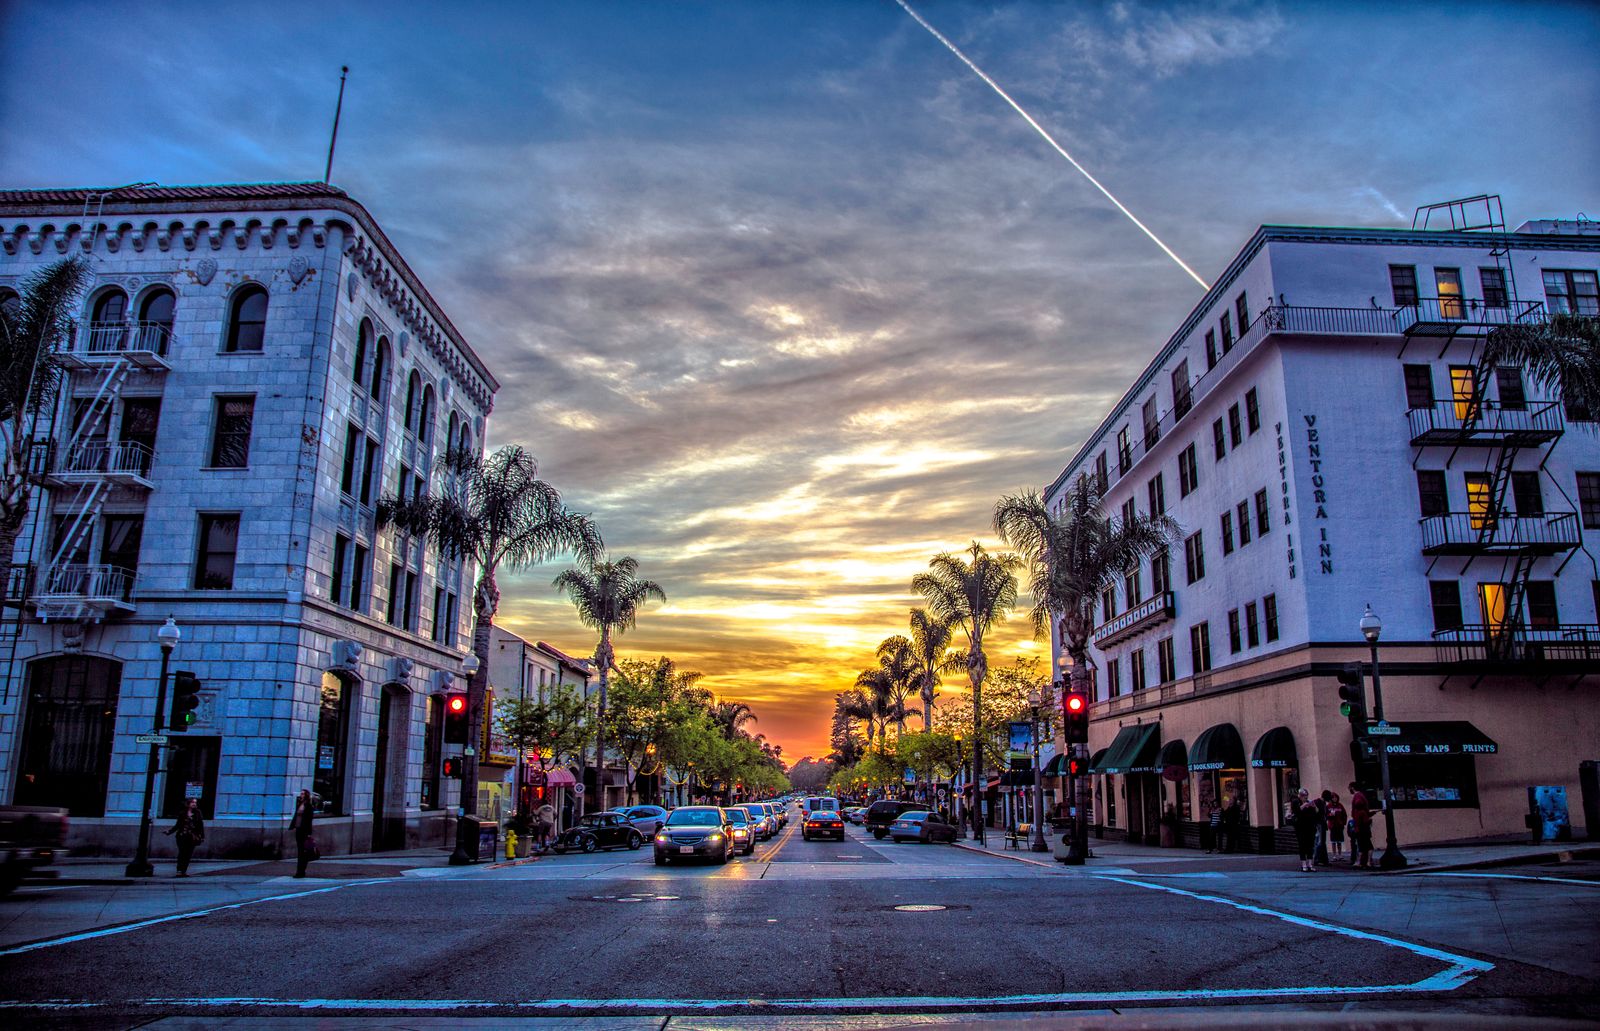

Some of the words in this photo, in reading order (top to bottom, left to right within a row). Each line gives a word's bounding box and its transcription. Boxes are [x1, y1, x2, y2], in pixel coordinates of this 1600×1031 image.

[1275, 421, 1292, 526] VENTURA
[1287, 534, 1296, 580] INN
[1304, 414, 1328, 519] VENTURA
[1319, 528, 1333, 575] INN
[1385, 744, 1411, 753] OOKS
[1425, 744, 1450, 753] MAPS
[1462, 744, 1496, 753] PRINTS
